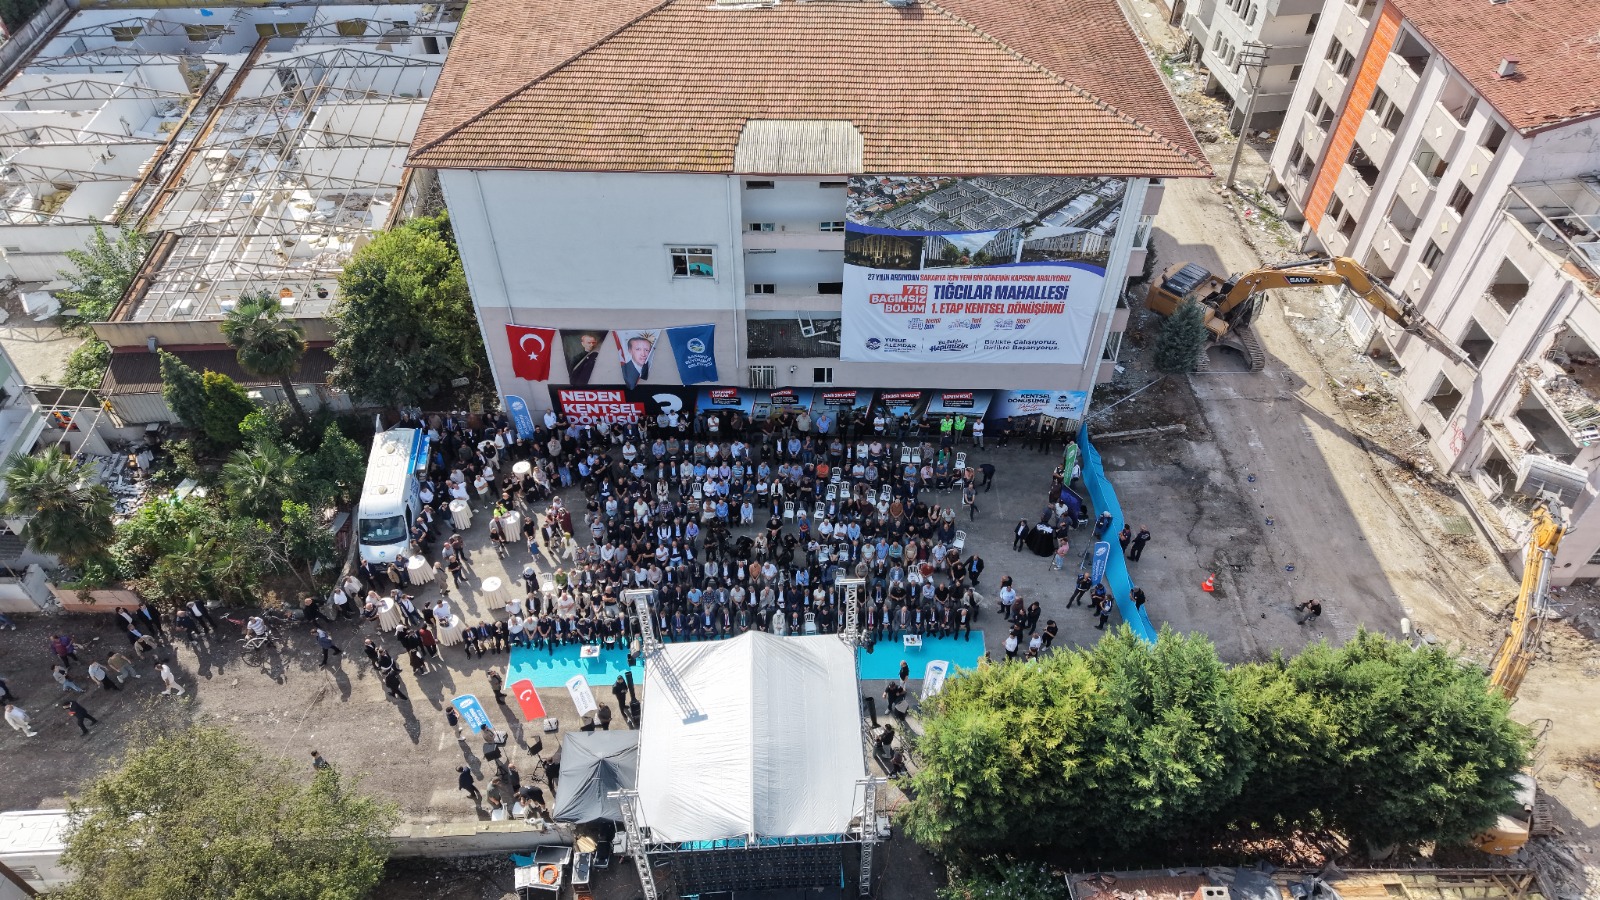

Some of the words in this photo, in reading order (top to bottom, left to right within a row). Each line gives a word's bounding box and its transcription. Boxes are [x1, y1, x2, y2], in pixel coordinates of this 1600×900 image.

[867, 273, 875, 281] 27
[906, 285, 927, 294] 718
[933, 282, 993, 300] TIĞCILAR
[994, 285, 1070, 300] MAHALLESİ
[871, 294, 927, 304] BAĞIMSIZ
[931, 302, 939, 314] 1.
[939, 302, 964, 314] ETAP
[964, 302, 1006, 315] KENTSEL
[1006, 301, 1066, 316] DÖNÜŞÜMÜ
[929, 342, 969, 352] Hepimizin
[560, 391, 622, 402] NEDEN
[563, 403, 642, 414] KENTSEL
[566, 412, 639, 425] DÖNÜŞÜ
